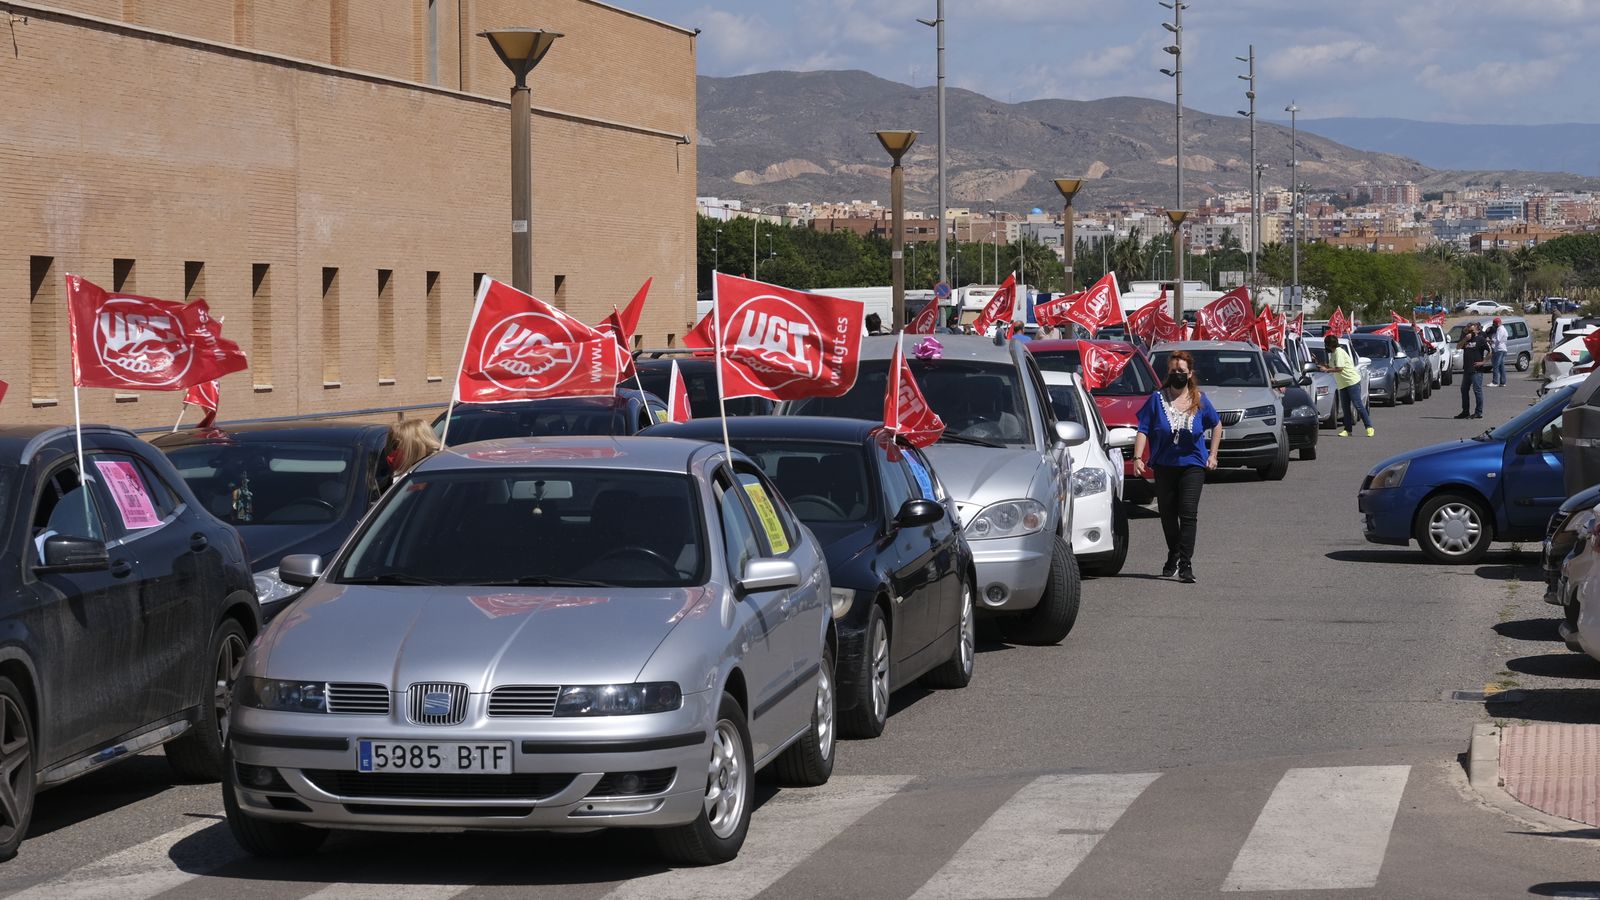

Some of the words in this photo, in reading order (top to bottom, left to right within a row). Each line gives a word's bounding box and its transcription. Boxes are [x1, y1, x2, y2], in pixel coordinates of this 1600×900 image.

[494, 322, 564, 356] UG
[737, 309, 810, 361] UGT
[363, 759, 369, 767] E
[374, 745, 441, 769] 5985
[458, 745, 507, 770] BTF
